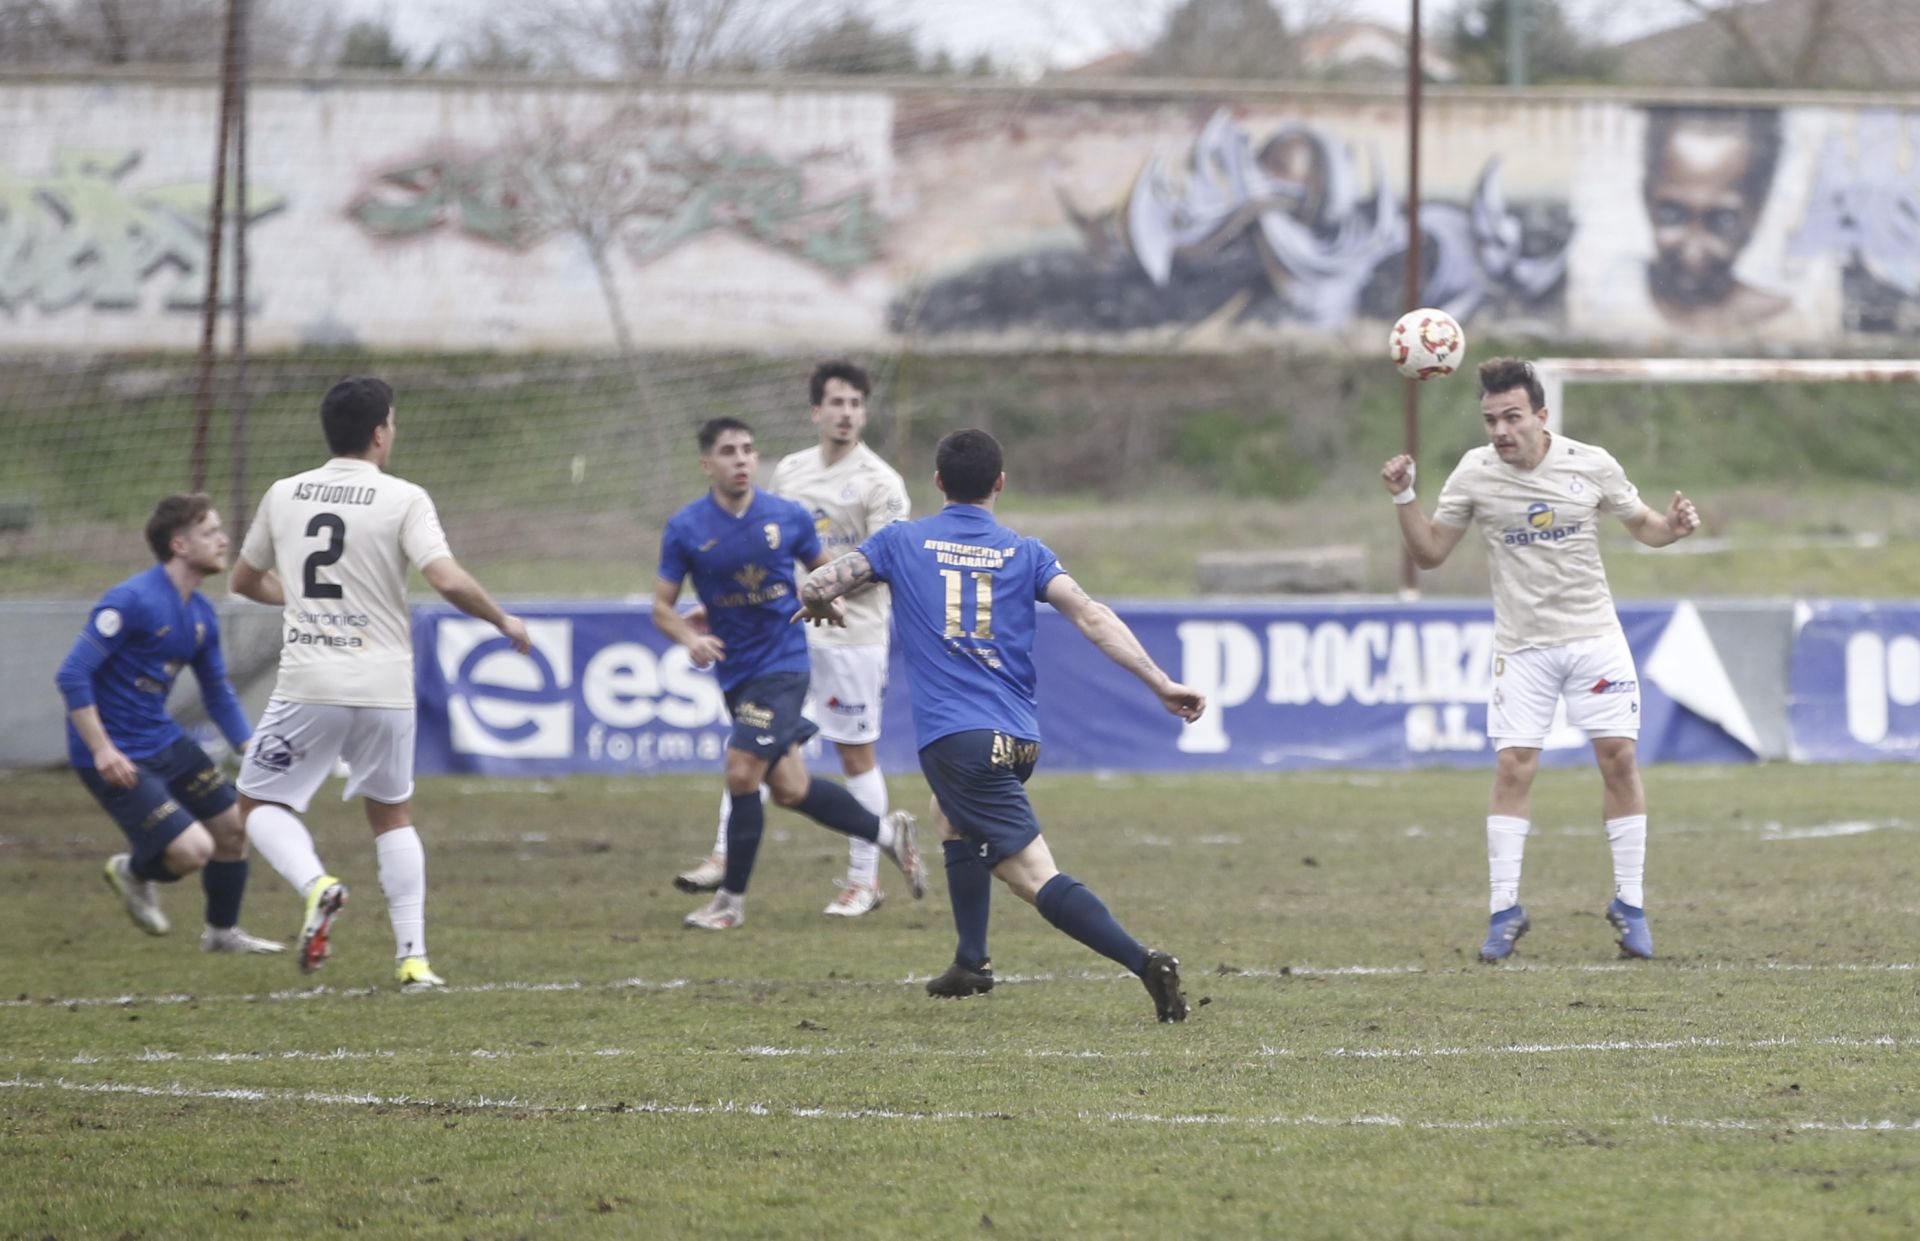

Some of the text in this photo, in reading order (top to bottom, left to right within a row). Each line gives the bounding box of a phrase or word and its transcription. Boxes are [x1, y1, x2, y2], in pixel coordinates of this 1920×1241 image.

[292, 482, 377, 506] ASTUDILLO
[304, 512, 346, 600] 2
[939, 568, 995, 640] 11
[288, 627, 363, 648] Danisa
[582, 641, 732, 729] es
[585, 721, 732, 762] forma
